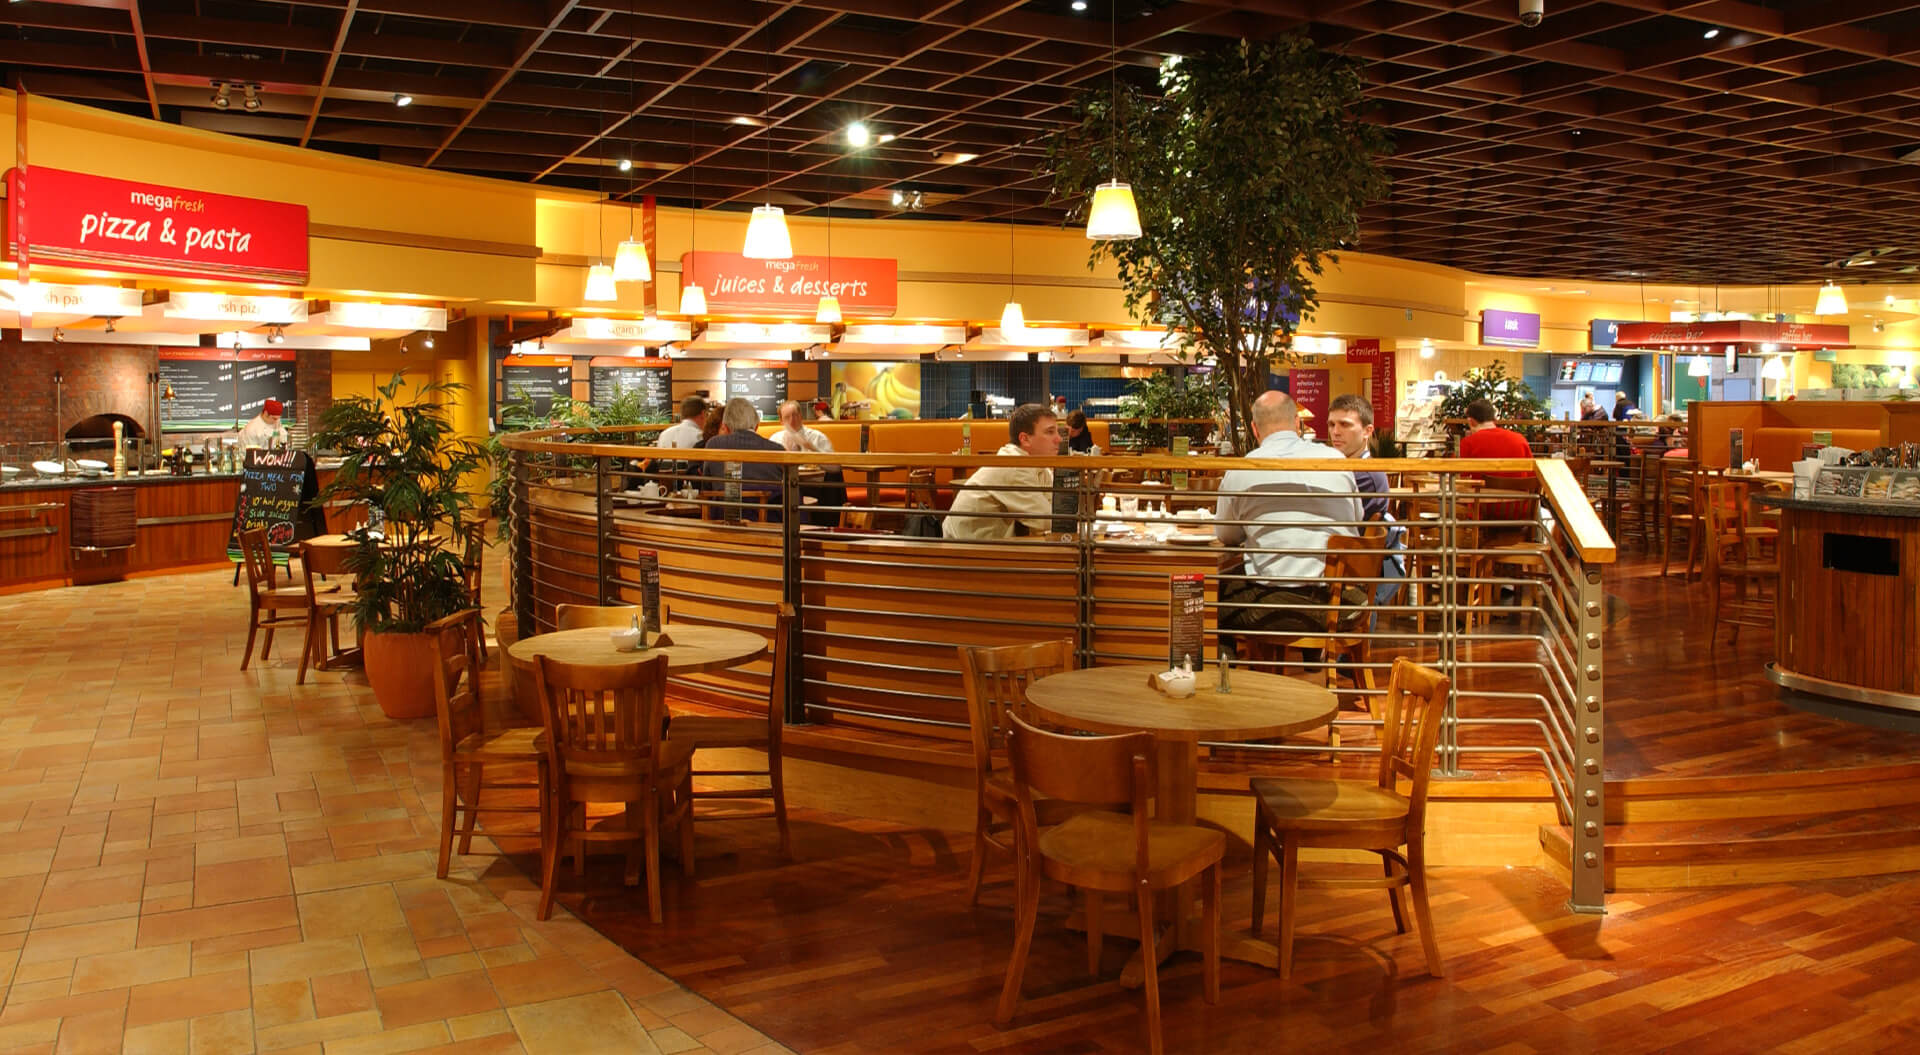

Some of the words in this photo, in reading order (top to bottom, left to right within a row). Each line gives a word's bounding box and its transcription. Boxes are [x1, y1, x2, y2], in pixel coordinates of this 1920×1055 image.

[80, 211, 151, 243] pizza
[160, 217, 176, 245] &
[184, 227, 251, 255] pasta
[710, 274, 766, 296] juices
[773, 275, 785, 294] &
[790, 276, 867, 296] desserts
